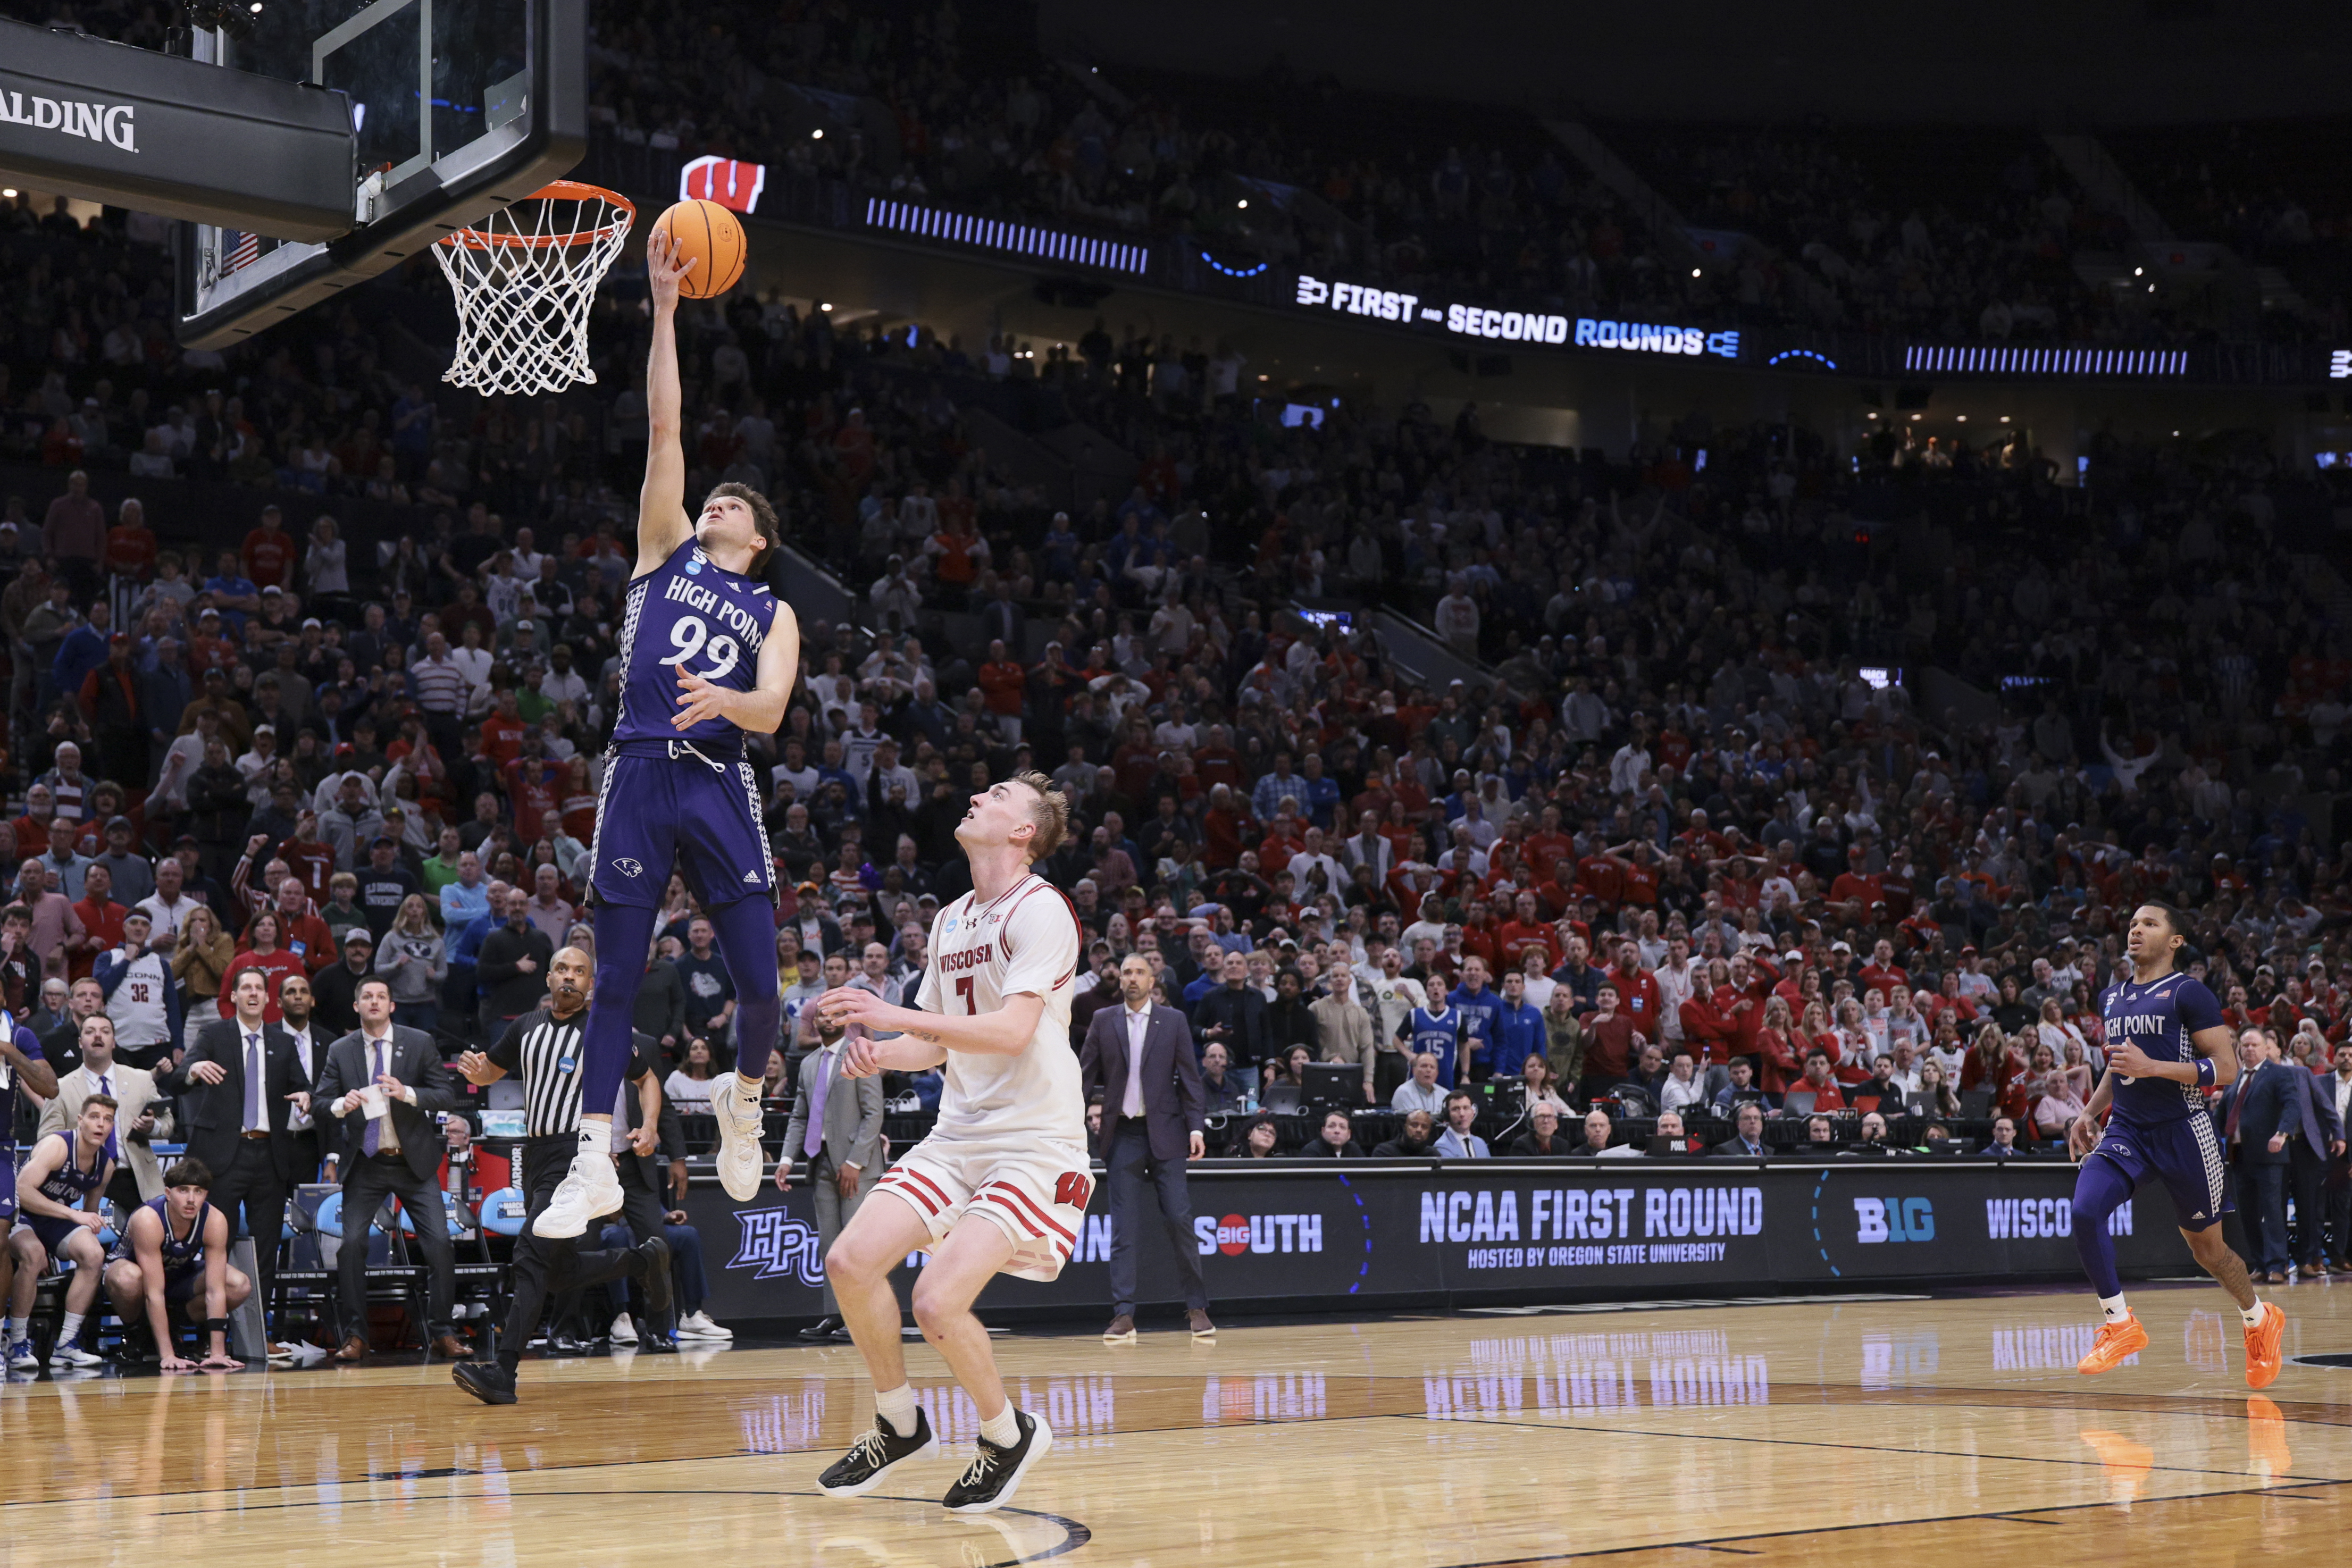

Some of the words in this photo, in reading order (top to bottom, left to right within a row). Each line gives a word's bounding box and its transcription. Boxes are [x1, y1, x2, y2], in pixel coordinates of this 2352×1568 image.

[1332, 282, 1418, 323] FIRST
[1420, 307, 1443, 322] AND
[1447, 304, 1568, 344] SECOND
[1575, 318, 1705, 356] ROUNDS
[664, 575, 719, 614] HIGH
[716, 600, 764, 655] POIN
[658, 615, 739, 679] 99
[127, 971, 160, 980] CONN
[131, 984, 148, 1002] 32
[956, 975, 976, 1016] 7
[2124, 1015, 2165, 1035] POINT
[1425, 1038, 1445, 1059] 15
[1670, 1140, 1687, 1151] POSS.
[1420, 1190, 1519, 1243] NCAA
[1531, 1188, 1634, 1240] FIRST
[1645, 1187, 1762, 1237] ROUND
[1986, 1198, 2133, 1239] WISCOIN
[1217, 1226, 1250, 1244] BIG
[1468, 1247, 1523, 1269] HOSTED
[1527, 1247, 1545, 1268] BY
[1549, 1246, 1604, 1267] OREGON
[1607, 1244, 1646, 1265] STATE
[1650, 1242, 1726, 1263] UNIVERSITY
